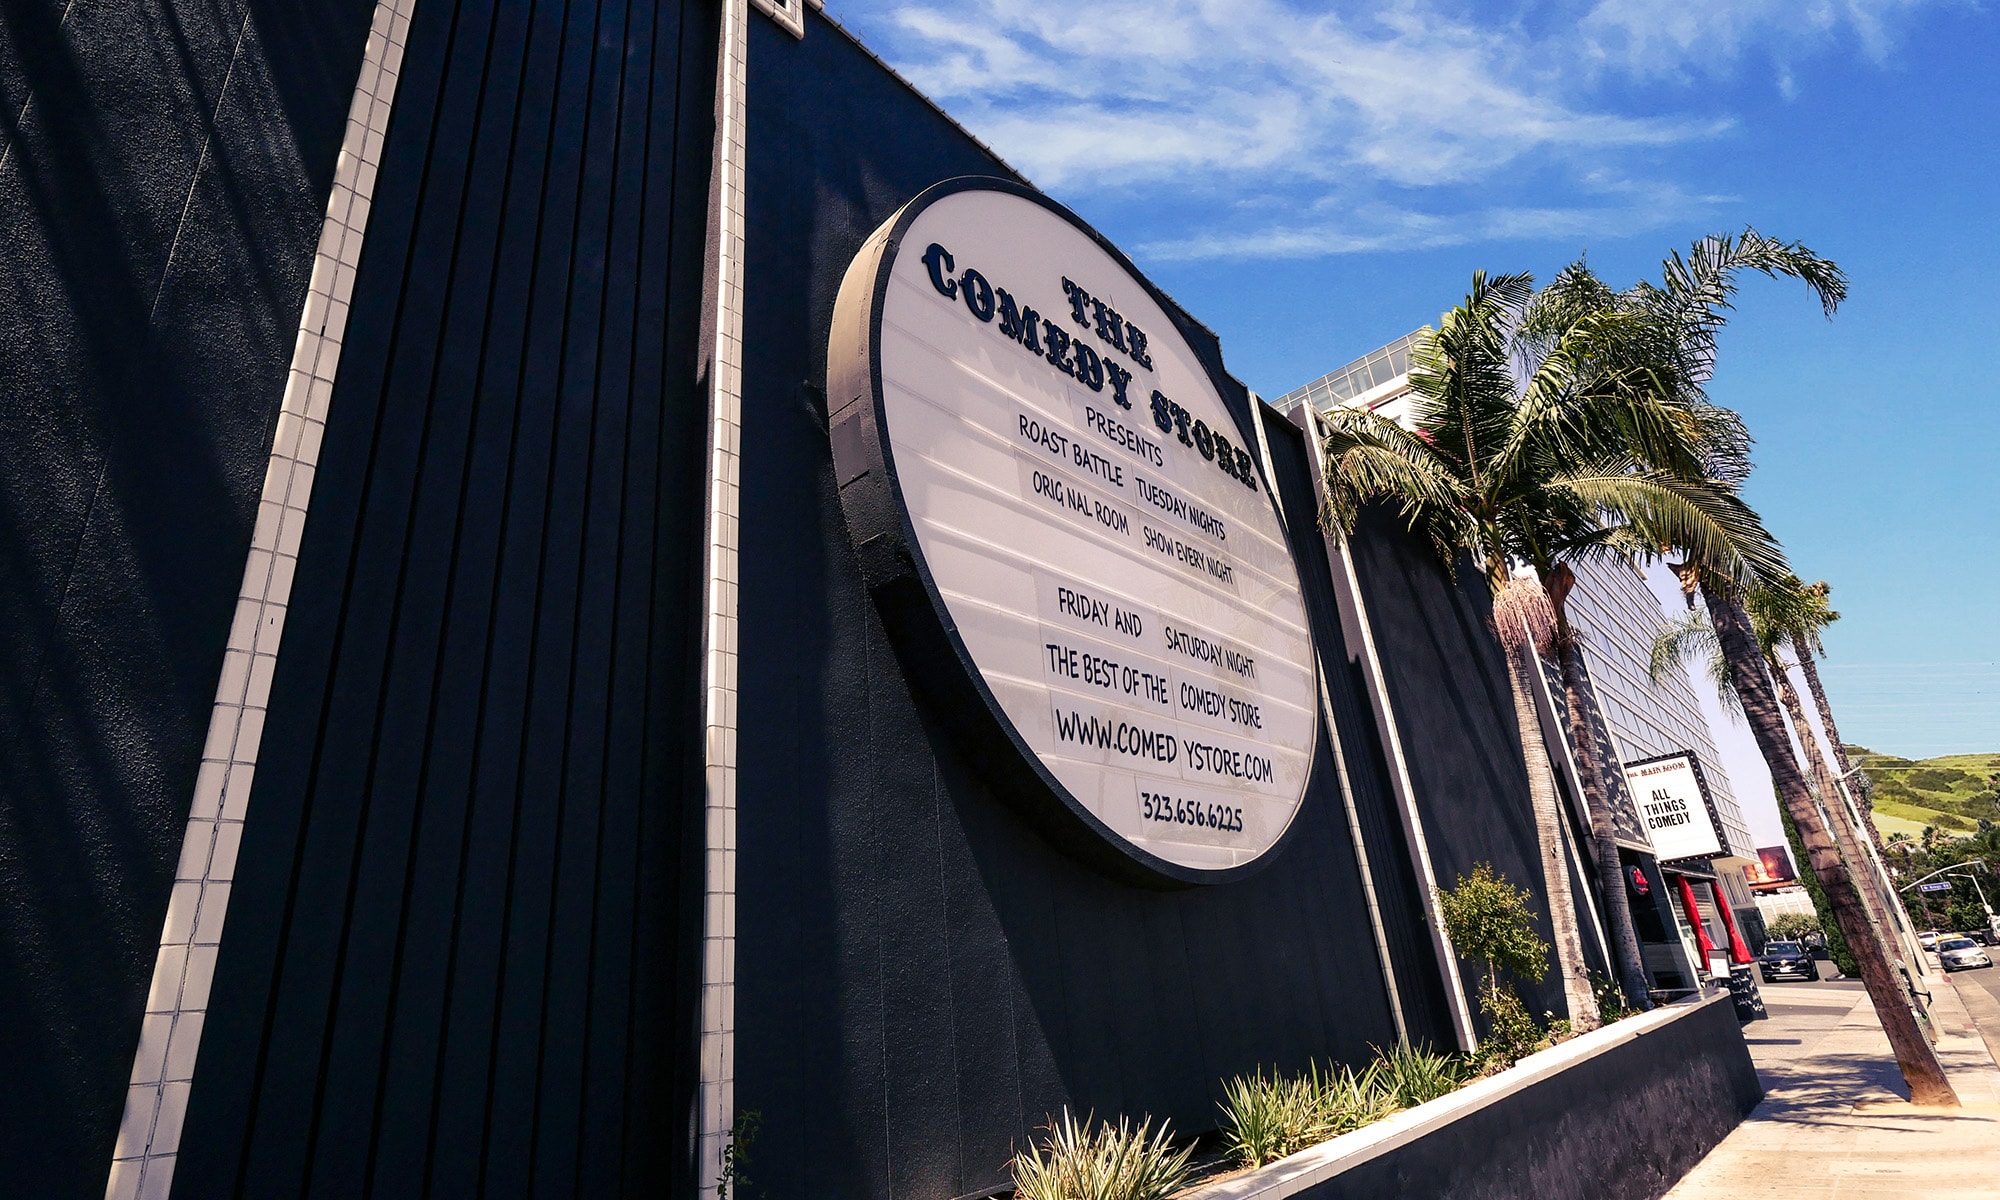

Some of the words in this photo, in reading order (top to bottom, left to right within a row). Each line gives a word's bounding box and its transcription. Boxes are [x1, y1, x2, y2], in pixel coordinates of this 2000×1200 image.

[1062, 276, 1153, 372] THE
[921, 242, 1133, 410] COMEDY
[1150, 390, 1258, 492] STORE
[1086, 406, 1164, 467] PRESENTS
[1019, 414, 1068, 457] ROAST
[1072, 443, 1124, 487] BATTLE
[1135, 476, 1189, 520] TUESDAY
[1189, 506, 1226, 541] NIGHTS
[1095, 500, 1130, 536] ROOM
[1143, 525, 1174, 557] SHOW
[1176, 541, 1206, 570] EVERY
[1207, 555, 1233, 585] NIGHT
[1058, 587, 1109, 628] FRIDAY
[1115, 608, 1142, 638] AND
[1165, 626, 1222, 667] SATURDAY
[1226, 650, 1255, 679] NIGHT
[1046, 644, 1079, 679] THE
[1083, 653, 1118, 688] BEST
[1123, 669, 1139, 695] OF
[1141, 673, 1168, 705] THE
[1180, 681, 1226, 720] COMEDY
[1229, 699, 1262, 729] STORE
[1641, 767, 1662, 777] MAIN
[1644, 798, 1687, 816] THINGS
[1651, 788, 1670, 802] ALL
[1141, 792, 1243, 832] 323.656.6225
[1648, 811, 1691, 830] COMEDY
